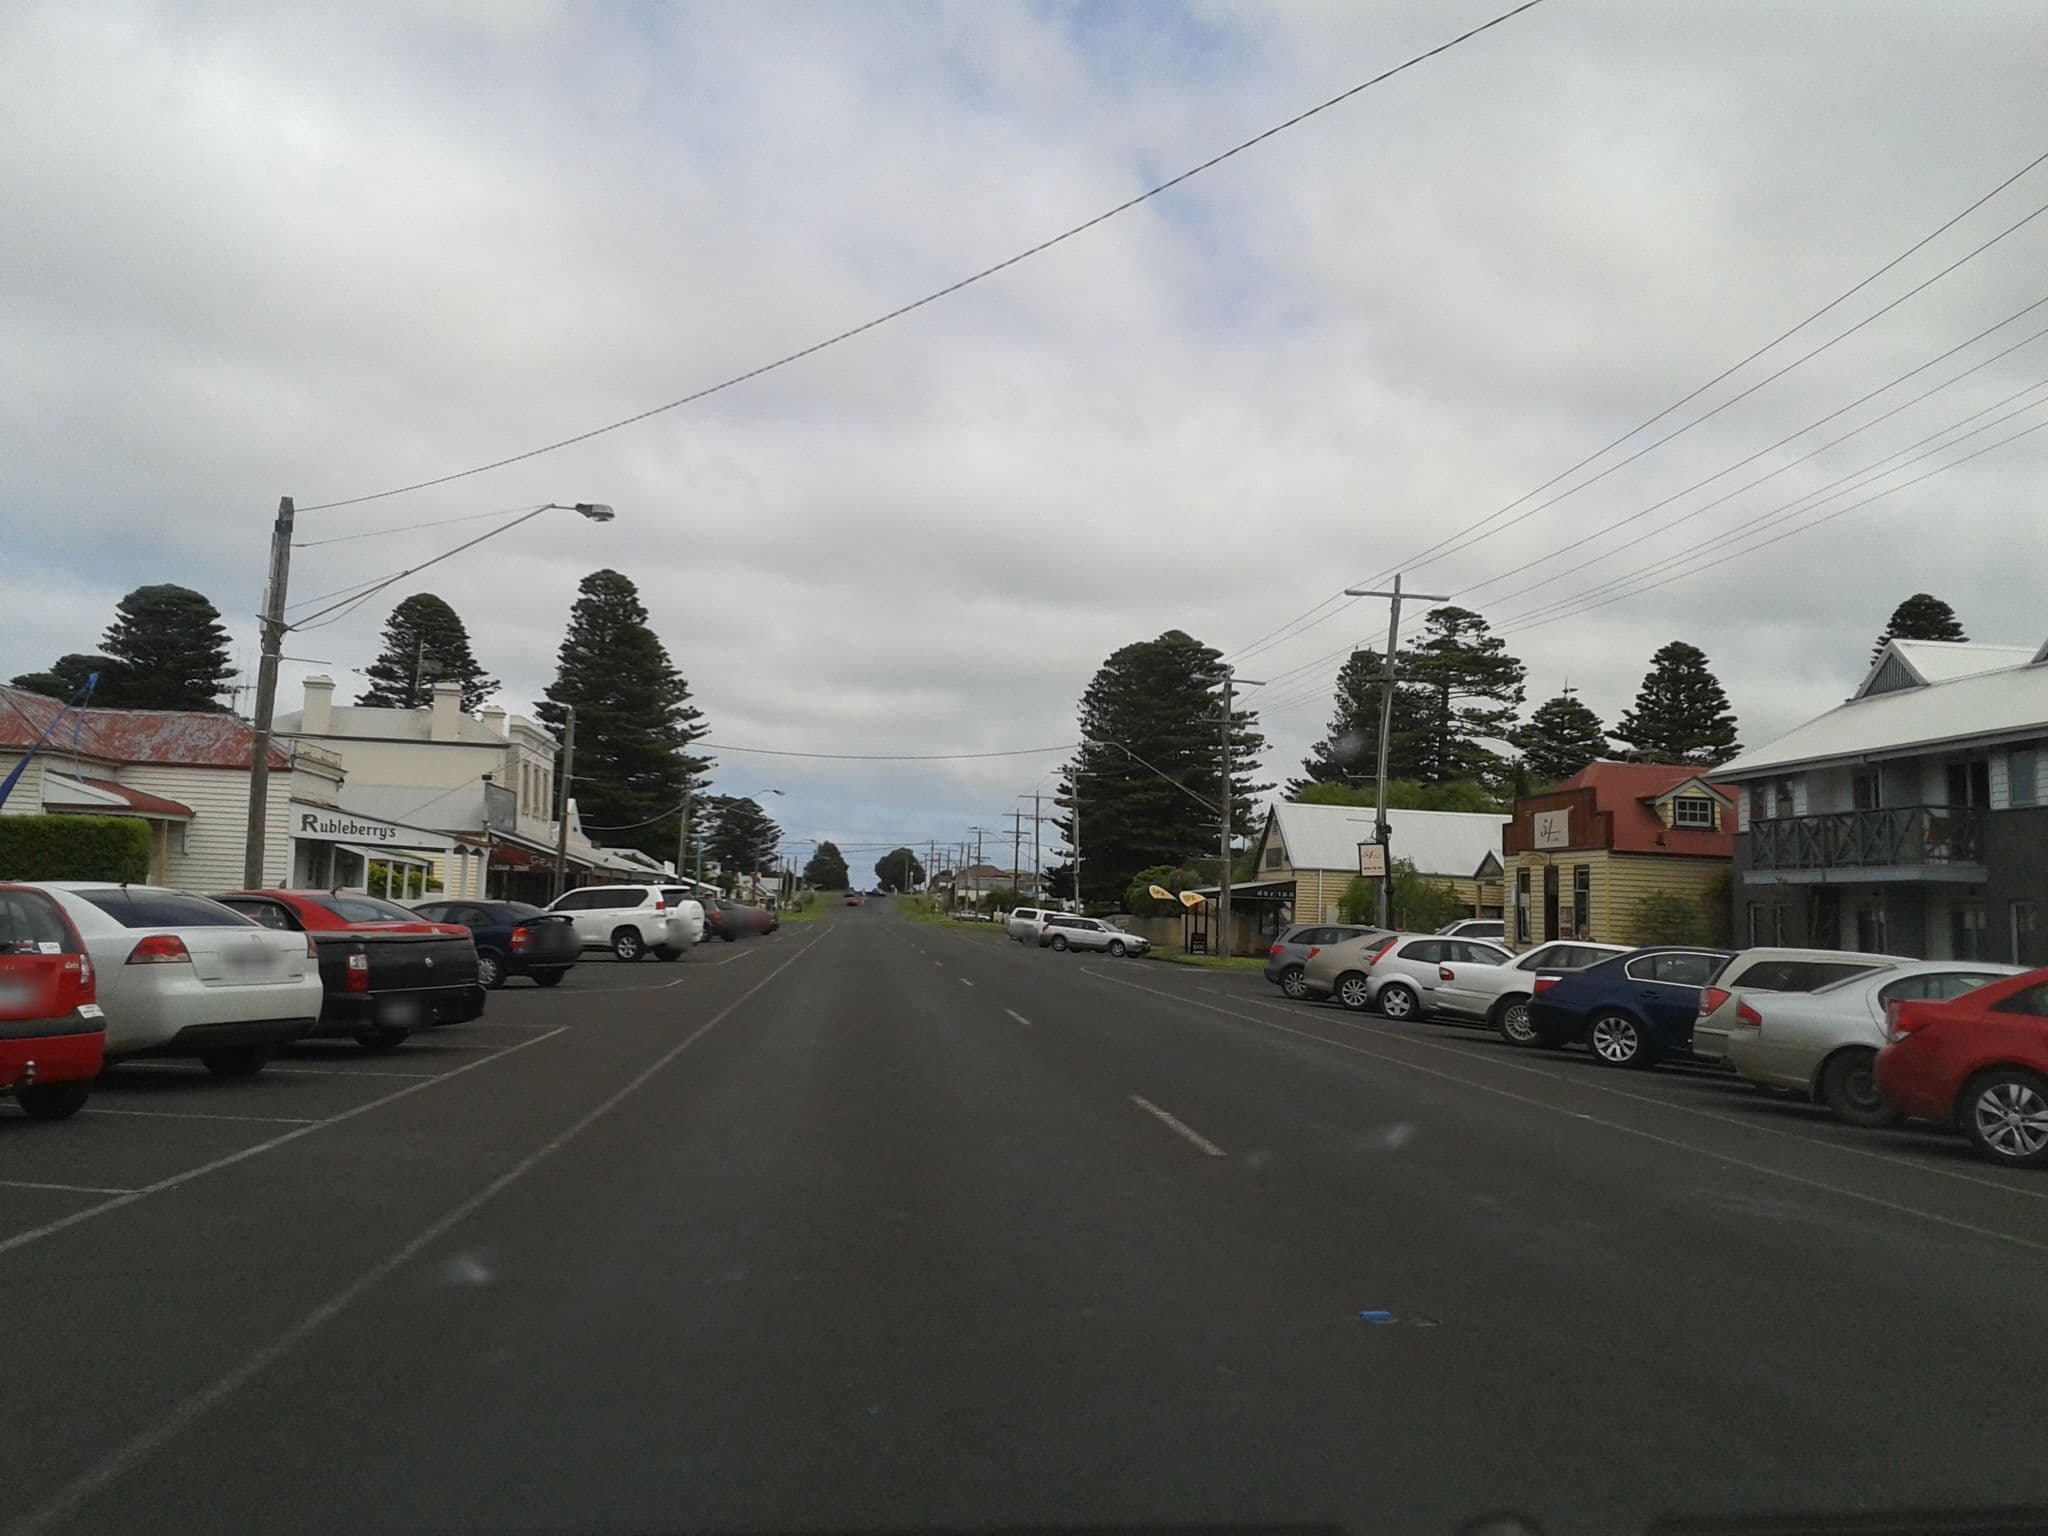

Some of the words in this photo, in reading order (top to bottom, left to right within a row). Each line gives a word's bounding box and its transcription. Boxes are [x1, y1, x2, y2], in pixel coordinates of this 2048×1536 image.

[301, 813, 397, 841] Rubleberry's
[1256, 890, 1274, 898] day
[1277, 890, 1295, 898] spa
